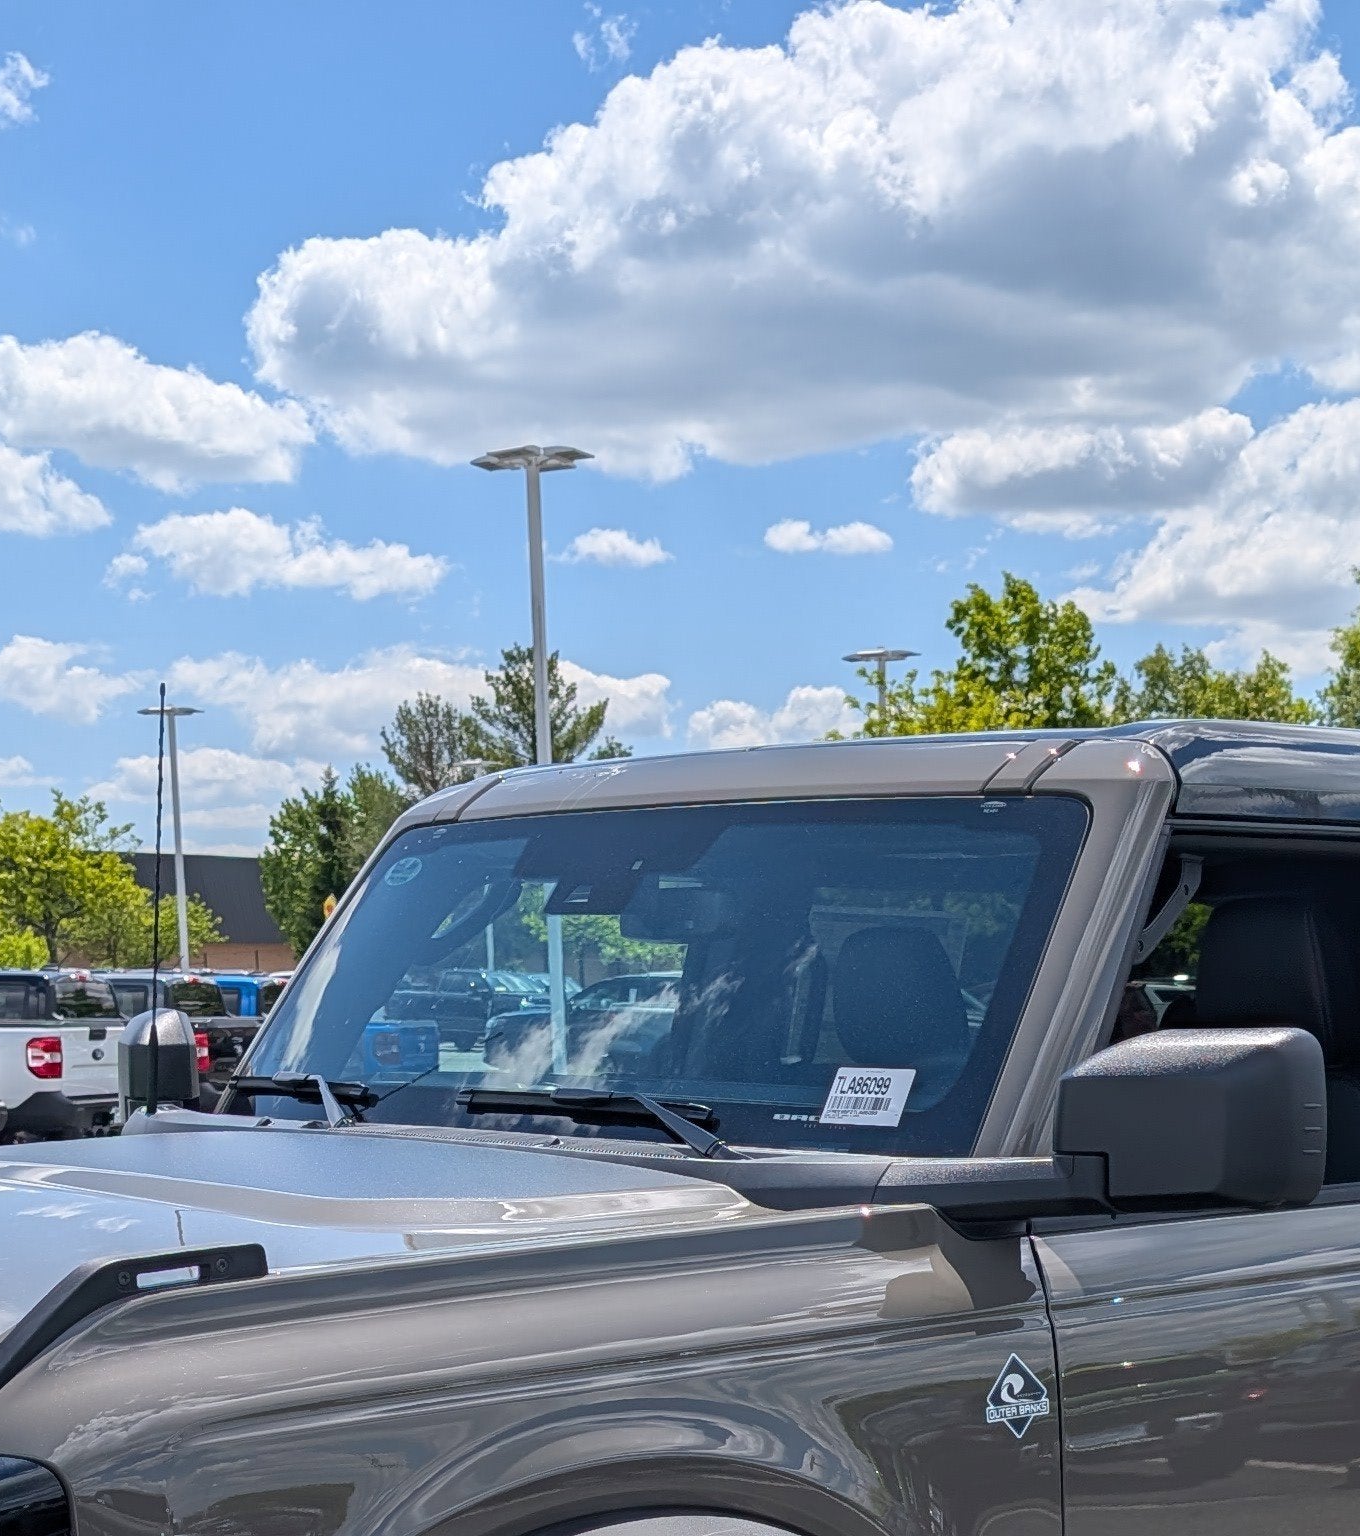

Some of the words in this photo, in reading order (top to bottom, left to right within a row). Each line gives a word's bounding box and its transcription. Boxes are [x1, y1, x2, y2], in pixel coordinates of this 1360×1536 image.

[835, 1075, 891, 1096] TLA86099
[989, 1407, 1017, 1420] OUTER
[1019, 1402, 1047, 1415] BANKS
